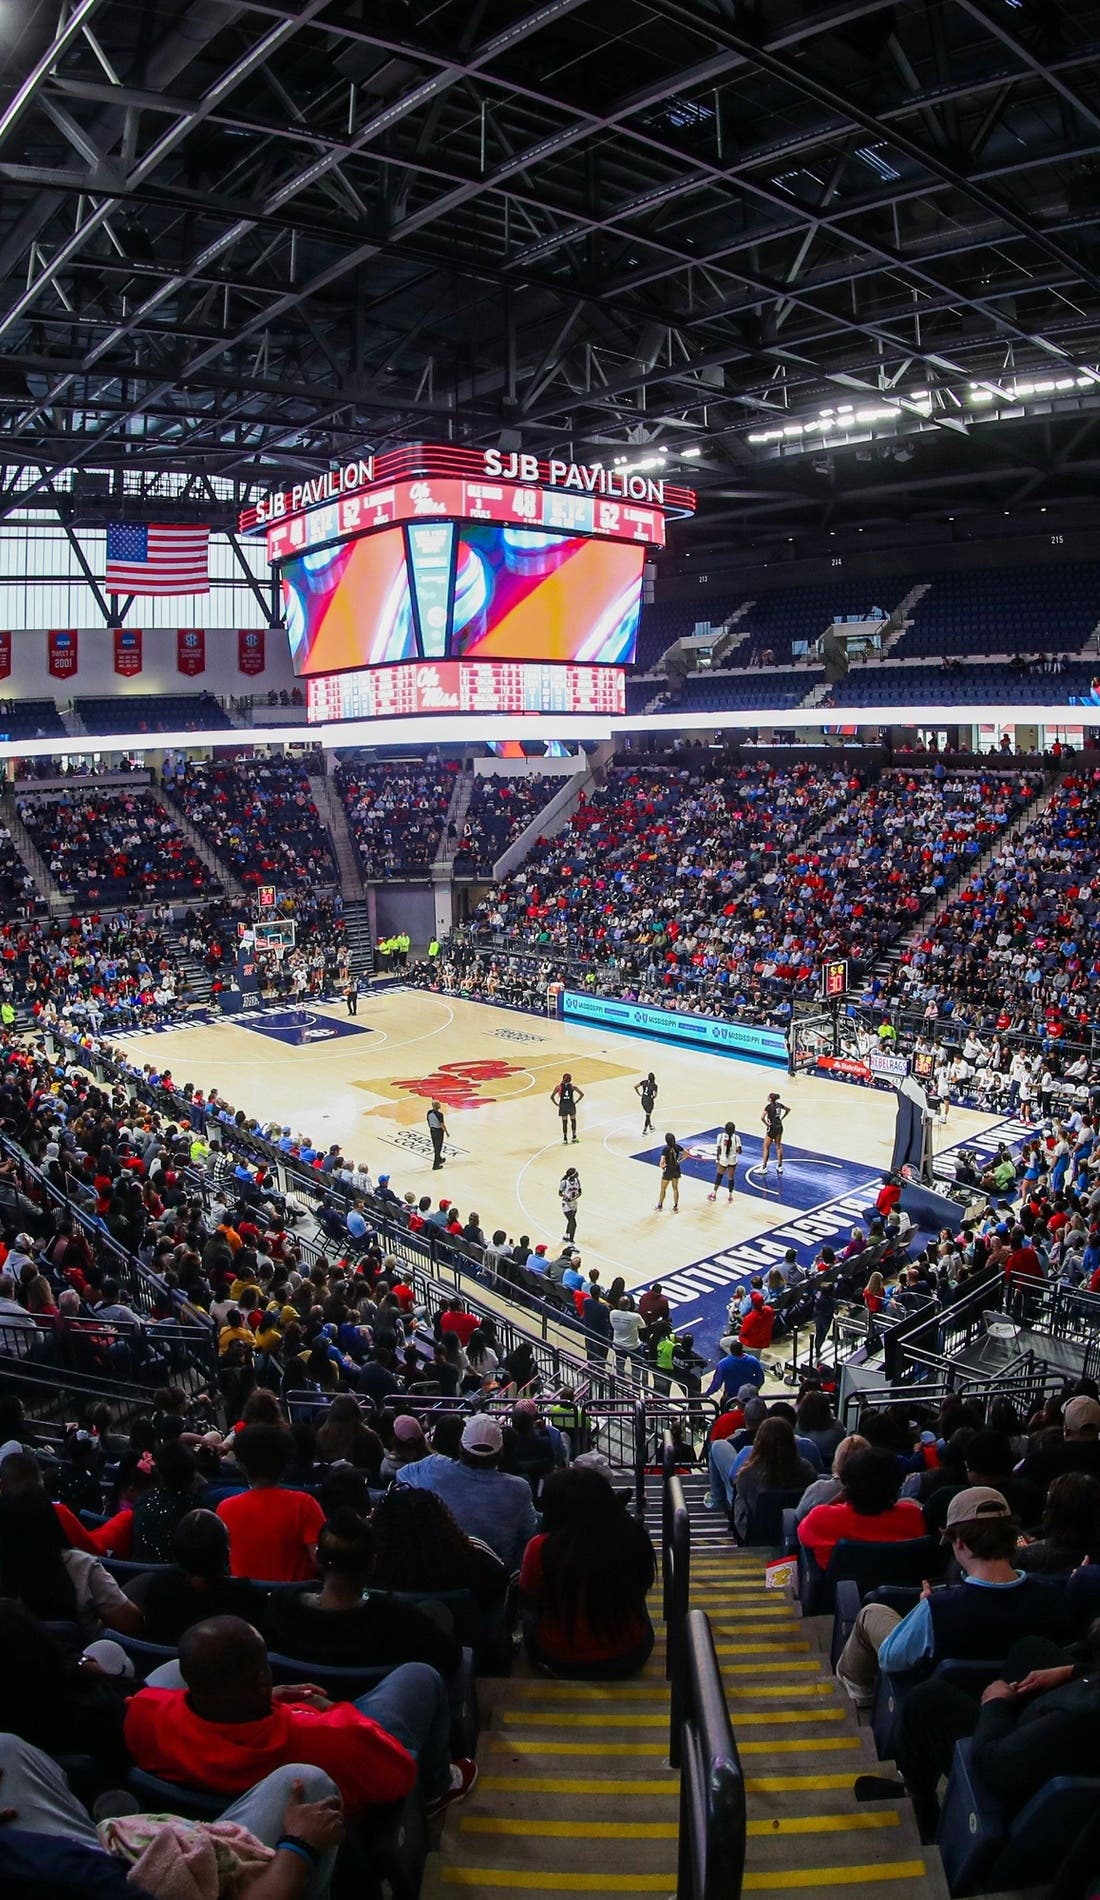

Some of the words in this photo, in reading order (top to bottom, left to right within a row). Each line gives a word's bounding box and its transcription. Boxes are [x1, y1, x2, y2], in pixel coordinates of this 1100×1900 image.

[483, 448, 540, 481] SJB
[549, 459, 665, 504] PAVILION
[256, 491, 286, 524] SJB
[292, 455, 375, 511] PAVILION
[600, 502, 620, 530] 52
[1050, 535, 1064, 544] 215
[54, 658, 72, 668] 2001
[261, 894, 272, 905] 30
[829, 974, 842, 993] 30
[578, 1001, 604, 1014] MISSISSIPPI
[649, 1016, 677, 1028] MISSISSIPPI
[728, 1031, 760, 1044] MISSISSIPPI
[772, 1197, 867, 1247] BLACK
